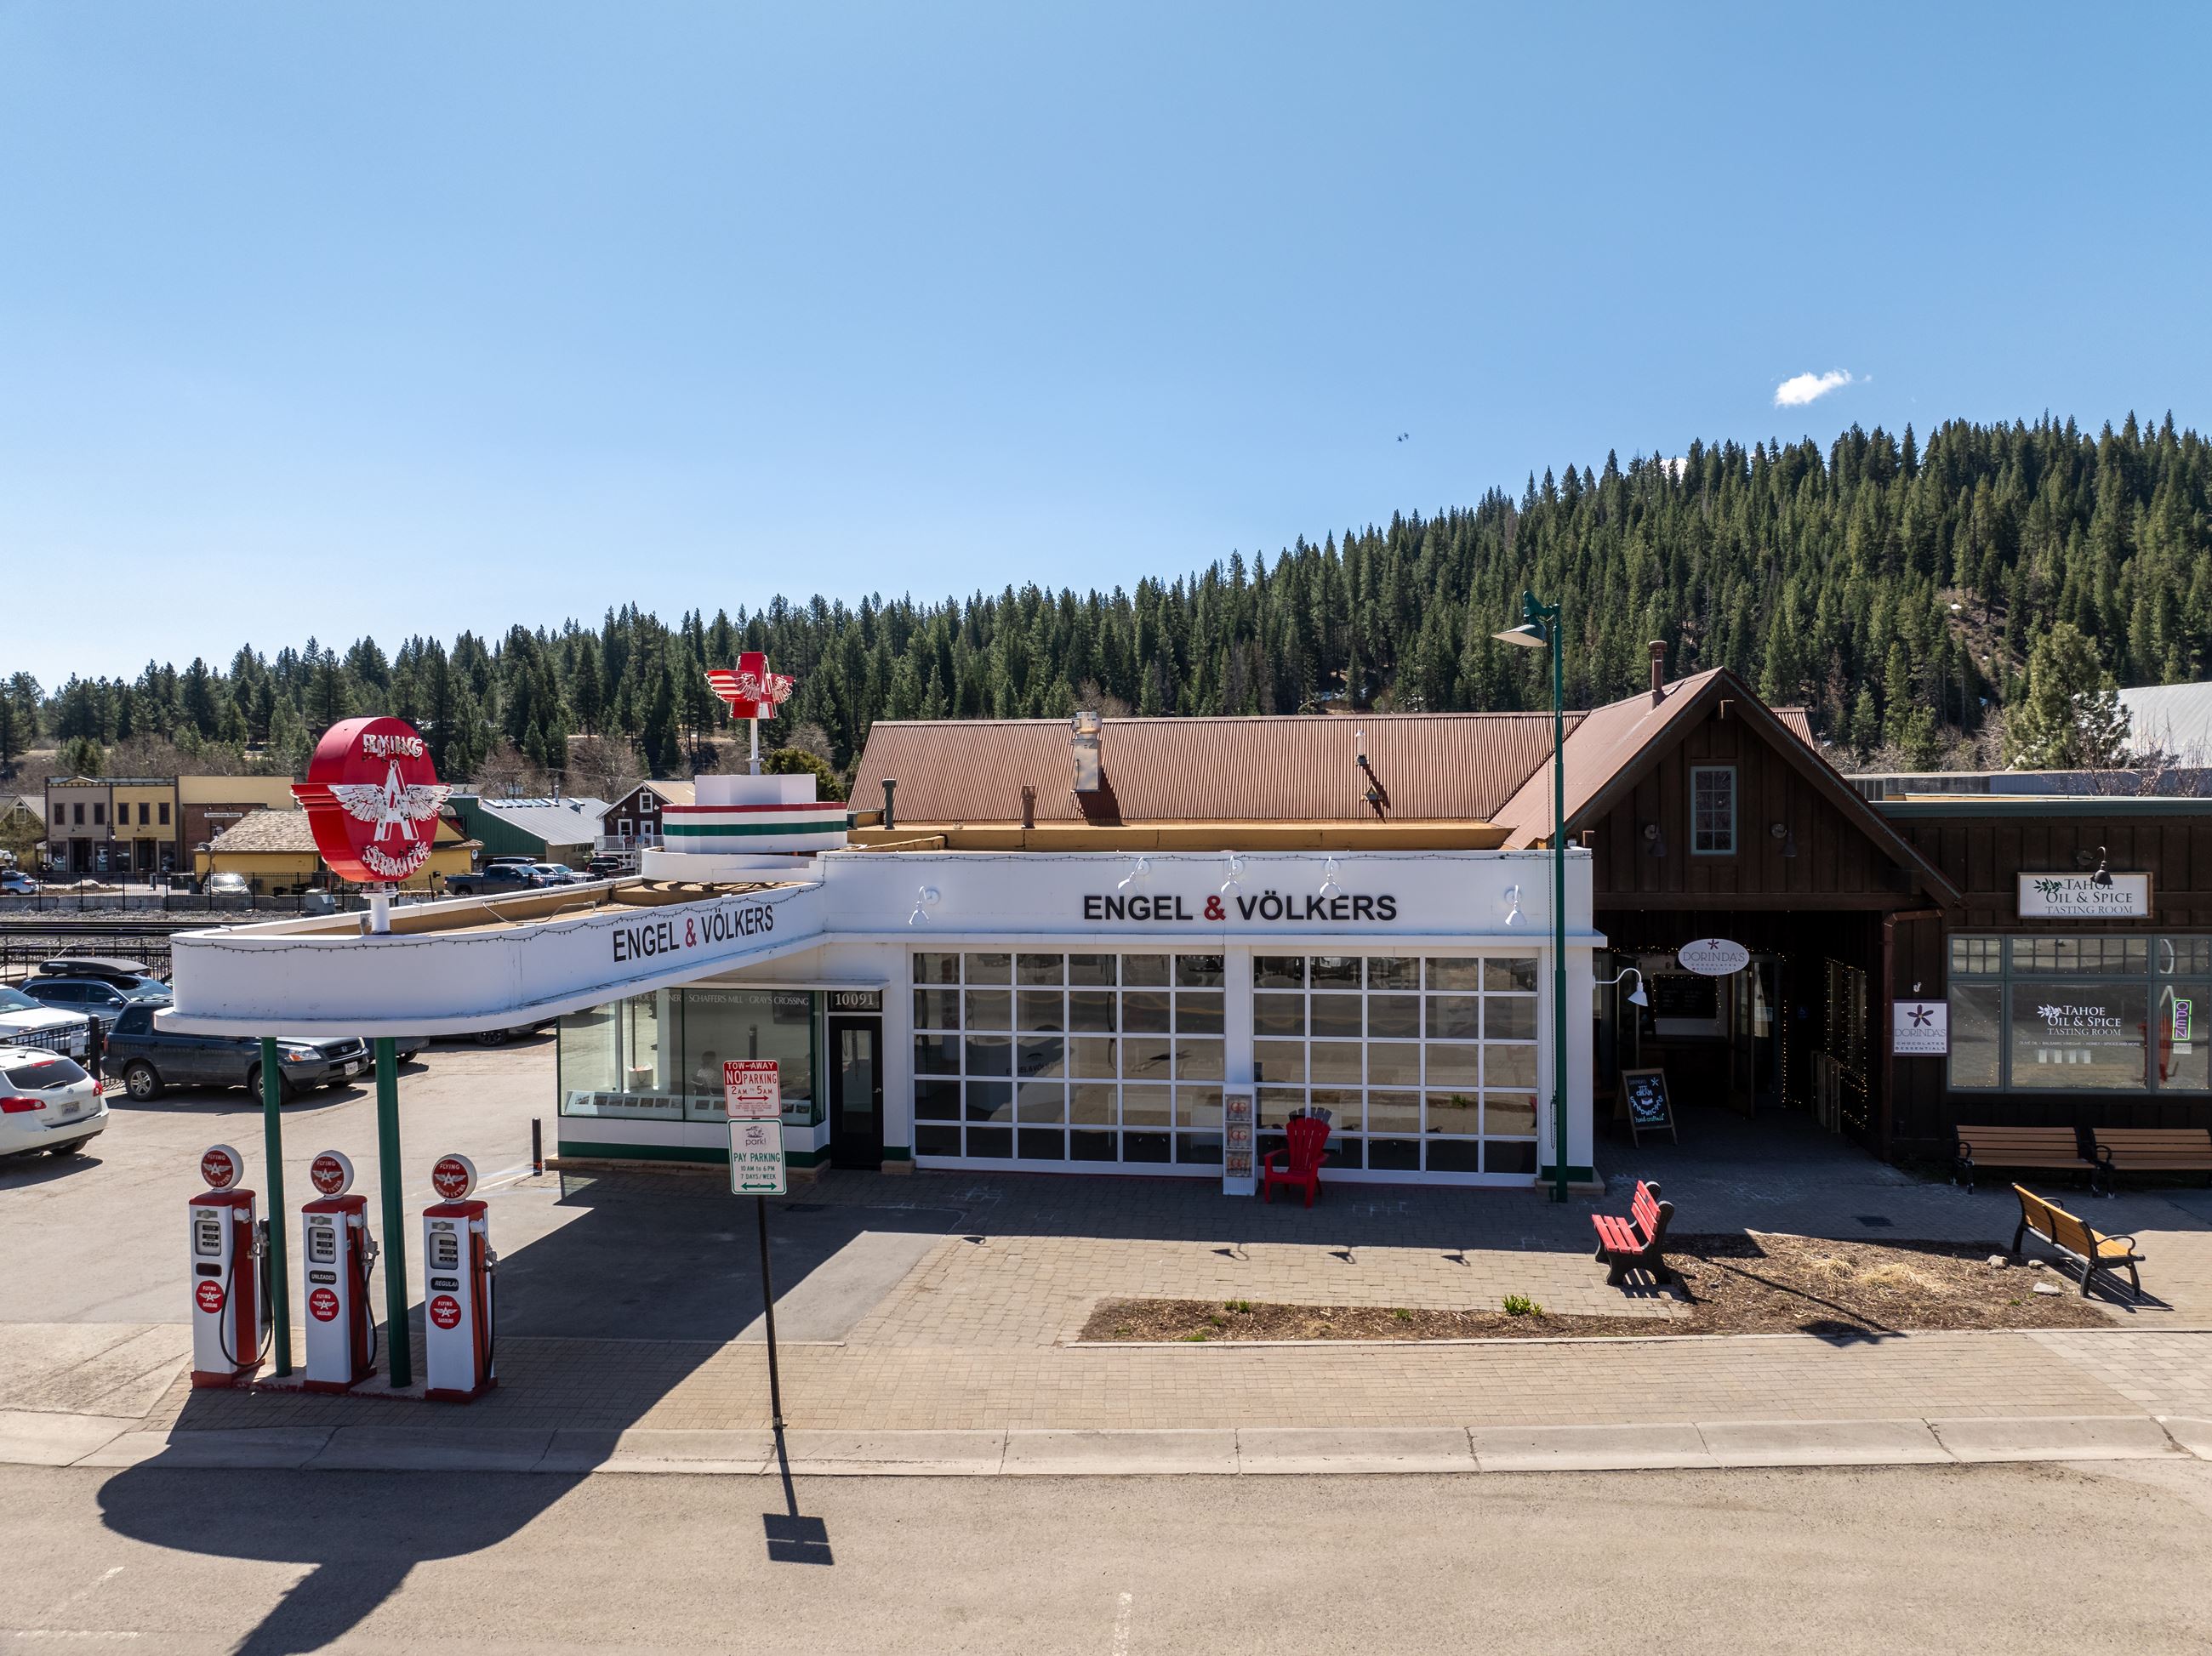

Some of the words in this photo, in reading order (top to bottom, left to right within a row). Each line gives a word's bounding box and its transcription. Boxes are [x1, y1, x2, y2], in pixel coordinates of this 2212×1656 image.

[363, 734, 423, 757] FLYING
[2046, 891, 2072, 903] OIL
[2077, 891, 2089, 903] &
[2093, 891, 2133, 903] SPICE
[1084, 895, 1194, 921] ENGEL
[1204, 895, 1226, 921] &
[1236, 890, 1397, 921] VÖLKERS
[2044, 906, 2095, 914] TASTING
[2098, 906, 2133, 914] ROOM
[613, 921, 680, 963] ENGEL
[685, 918, 697, 948] &
[701, 905, 773, 944] VÖLKERS
[1683, 952, 1745, 962] DORINDA'S
[689, 994, 727, 1004] SCHAFFER'S
[728, 995, 743, 1004] MILL
[749, 995, 772, 1004] GRAY'S
[773, 996, 809, 1006] CROSSING
[835, 993, 874, 1005] 10091
[2063, 1005, 2106, 1016] TAHOE
[2048, 1016, 2069, 1027] OIL
[2073, 1016, 2084, 1027] &
[2087, 1016, 2121, 1027] SPICE
[2175, 1002, 2189, 1039] OPEN
[727, 1062, 774, 1070] TOW-AWAY
[726, 1070, 741, 1084] NO
[743, 1074, 777, 1084] PARKING
[1630, 1095, 1663, 1116] SANDWICHES
[746, 1138, 766, 1147] park!
[733, 1152, 747, 1162] PAY
[750, 1152, 781, 1162] PARKING
[435, 1183, 450, 1197] SUPER
[450, 1184, 466, 1197] EXTRA
